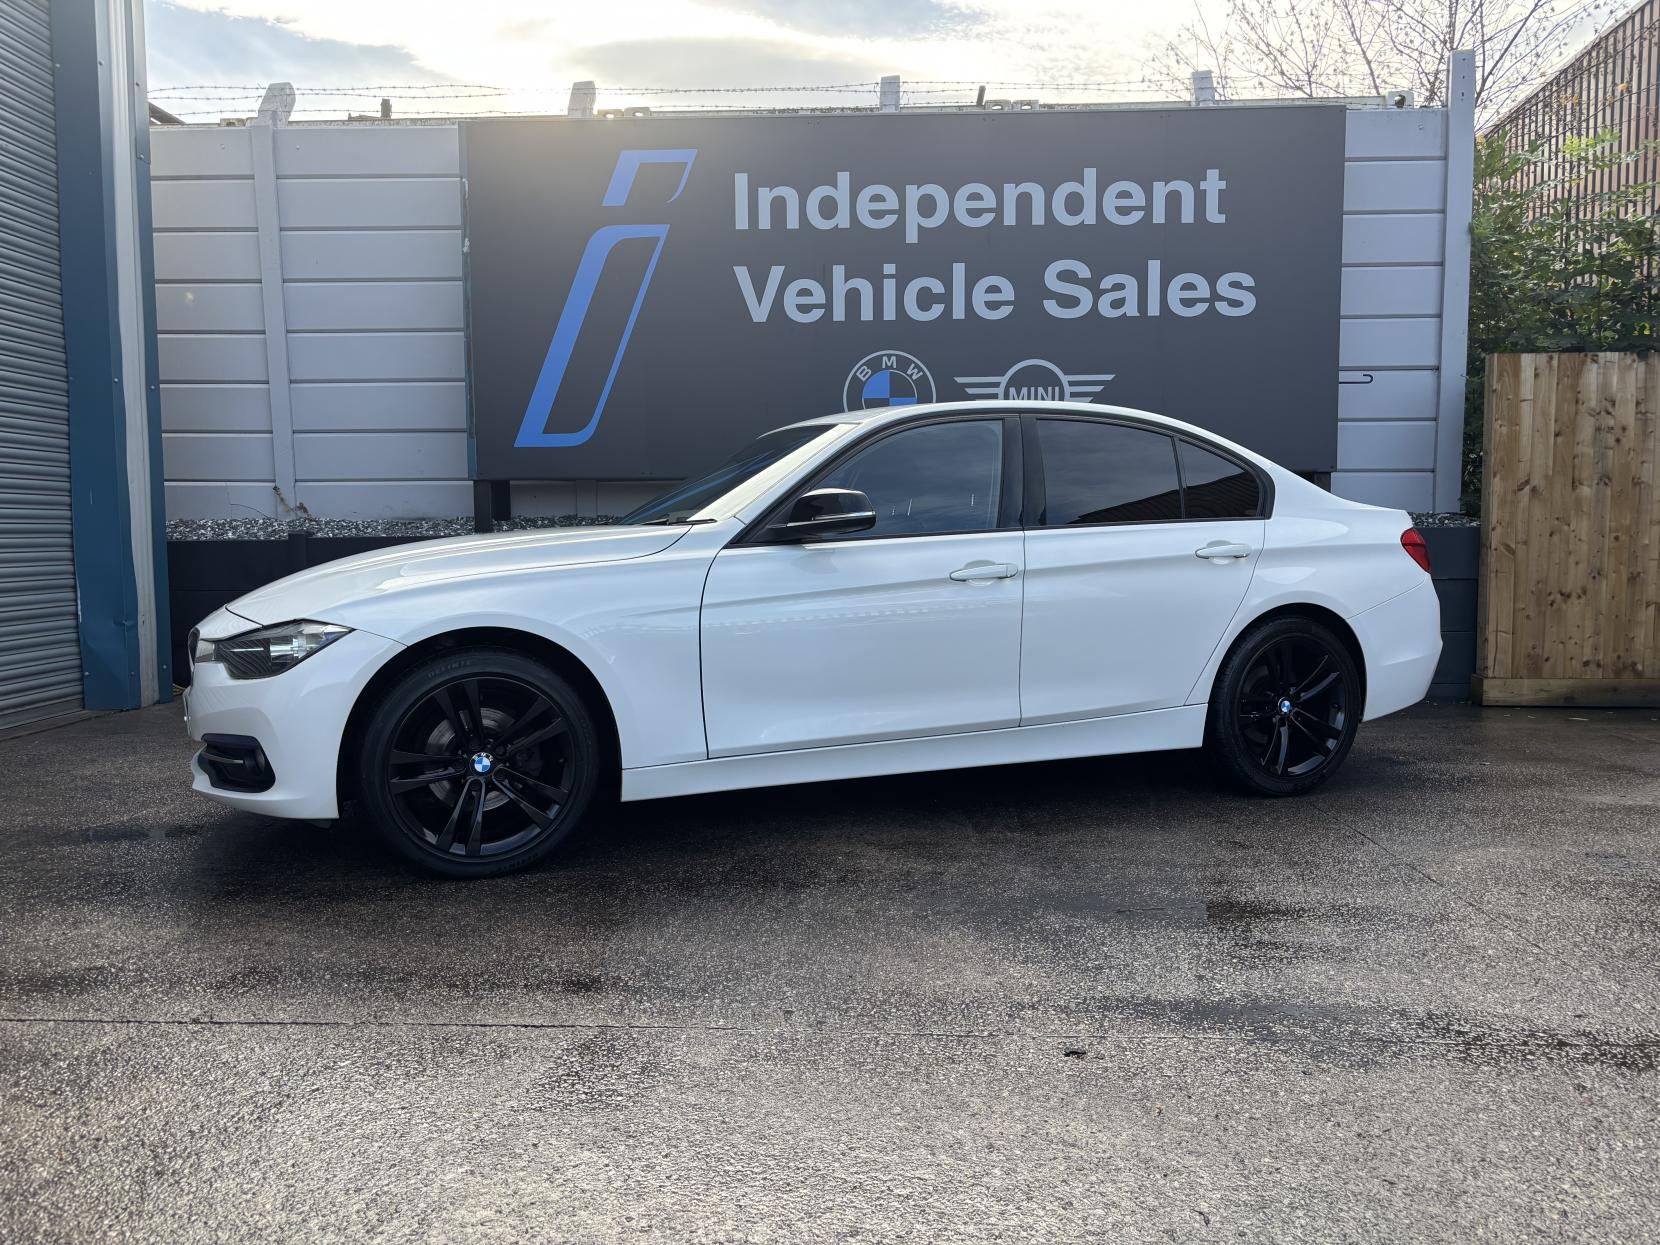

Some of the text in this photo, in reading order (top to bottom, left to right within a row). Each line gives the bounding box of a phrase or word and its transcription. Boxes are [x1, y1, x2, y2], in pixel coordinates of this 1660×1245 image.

[734, 167, 1227, 244] Independent
[733, 259, 1257, 323] Vehicle Sales
[856, 356, 924, 382] BMW
[1008, 386, 1060, 402] MINI
